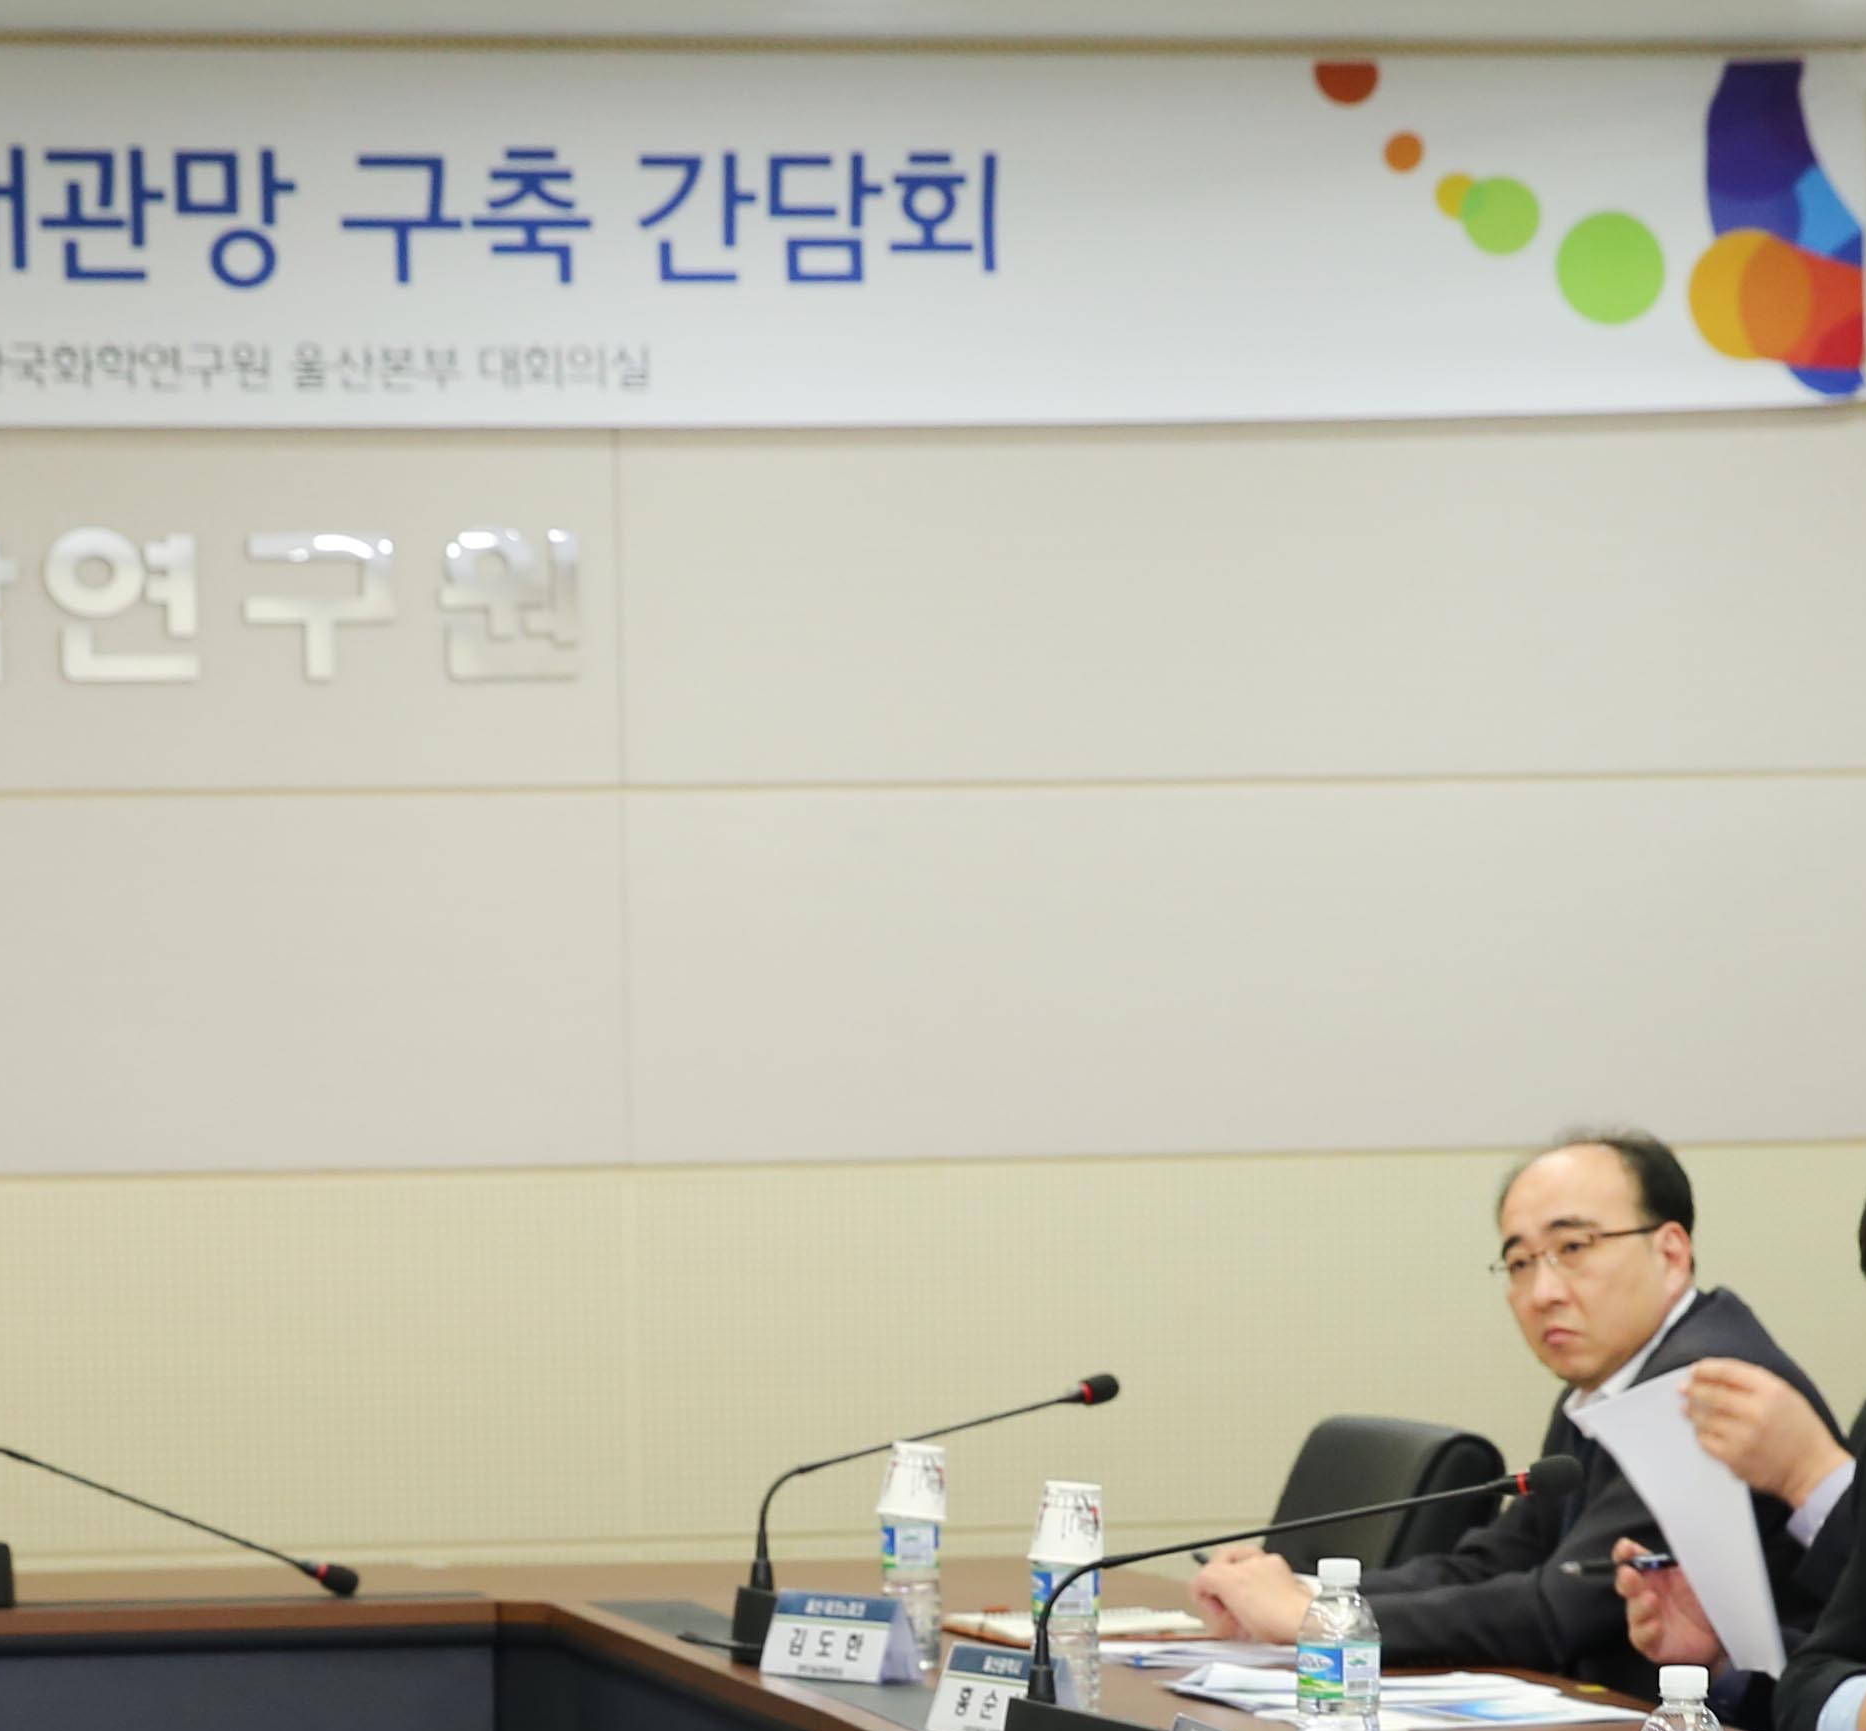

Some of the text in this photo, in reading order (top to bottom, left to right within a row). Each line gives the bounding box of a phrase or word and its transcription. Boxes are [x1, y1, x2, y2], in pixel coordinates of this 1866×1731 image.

[340, 148, 592, 286] 구축
[638, 152, 998, 285] 간담회
[289, 342, 462, 391] 울산본부
[477, 345, 651, 391] 대회의실
